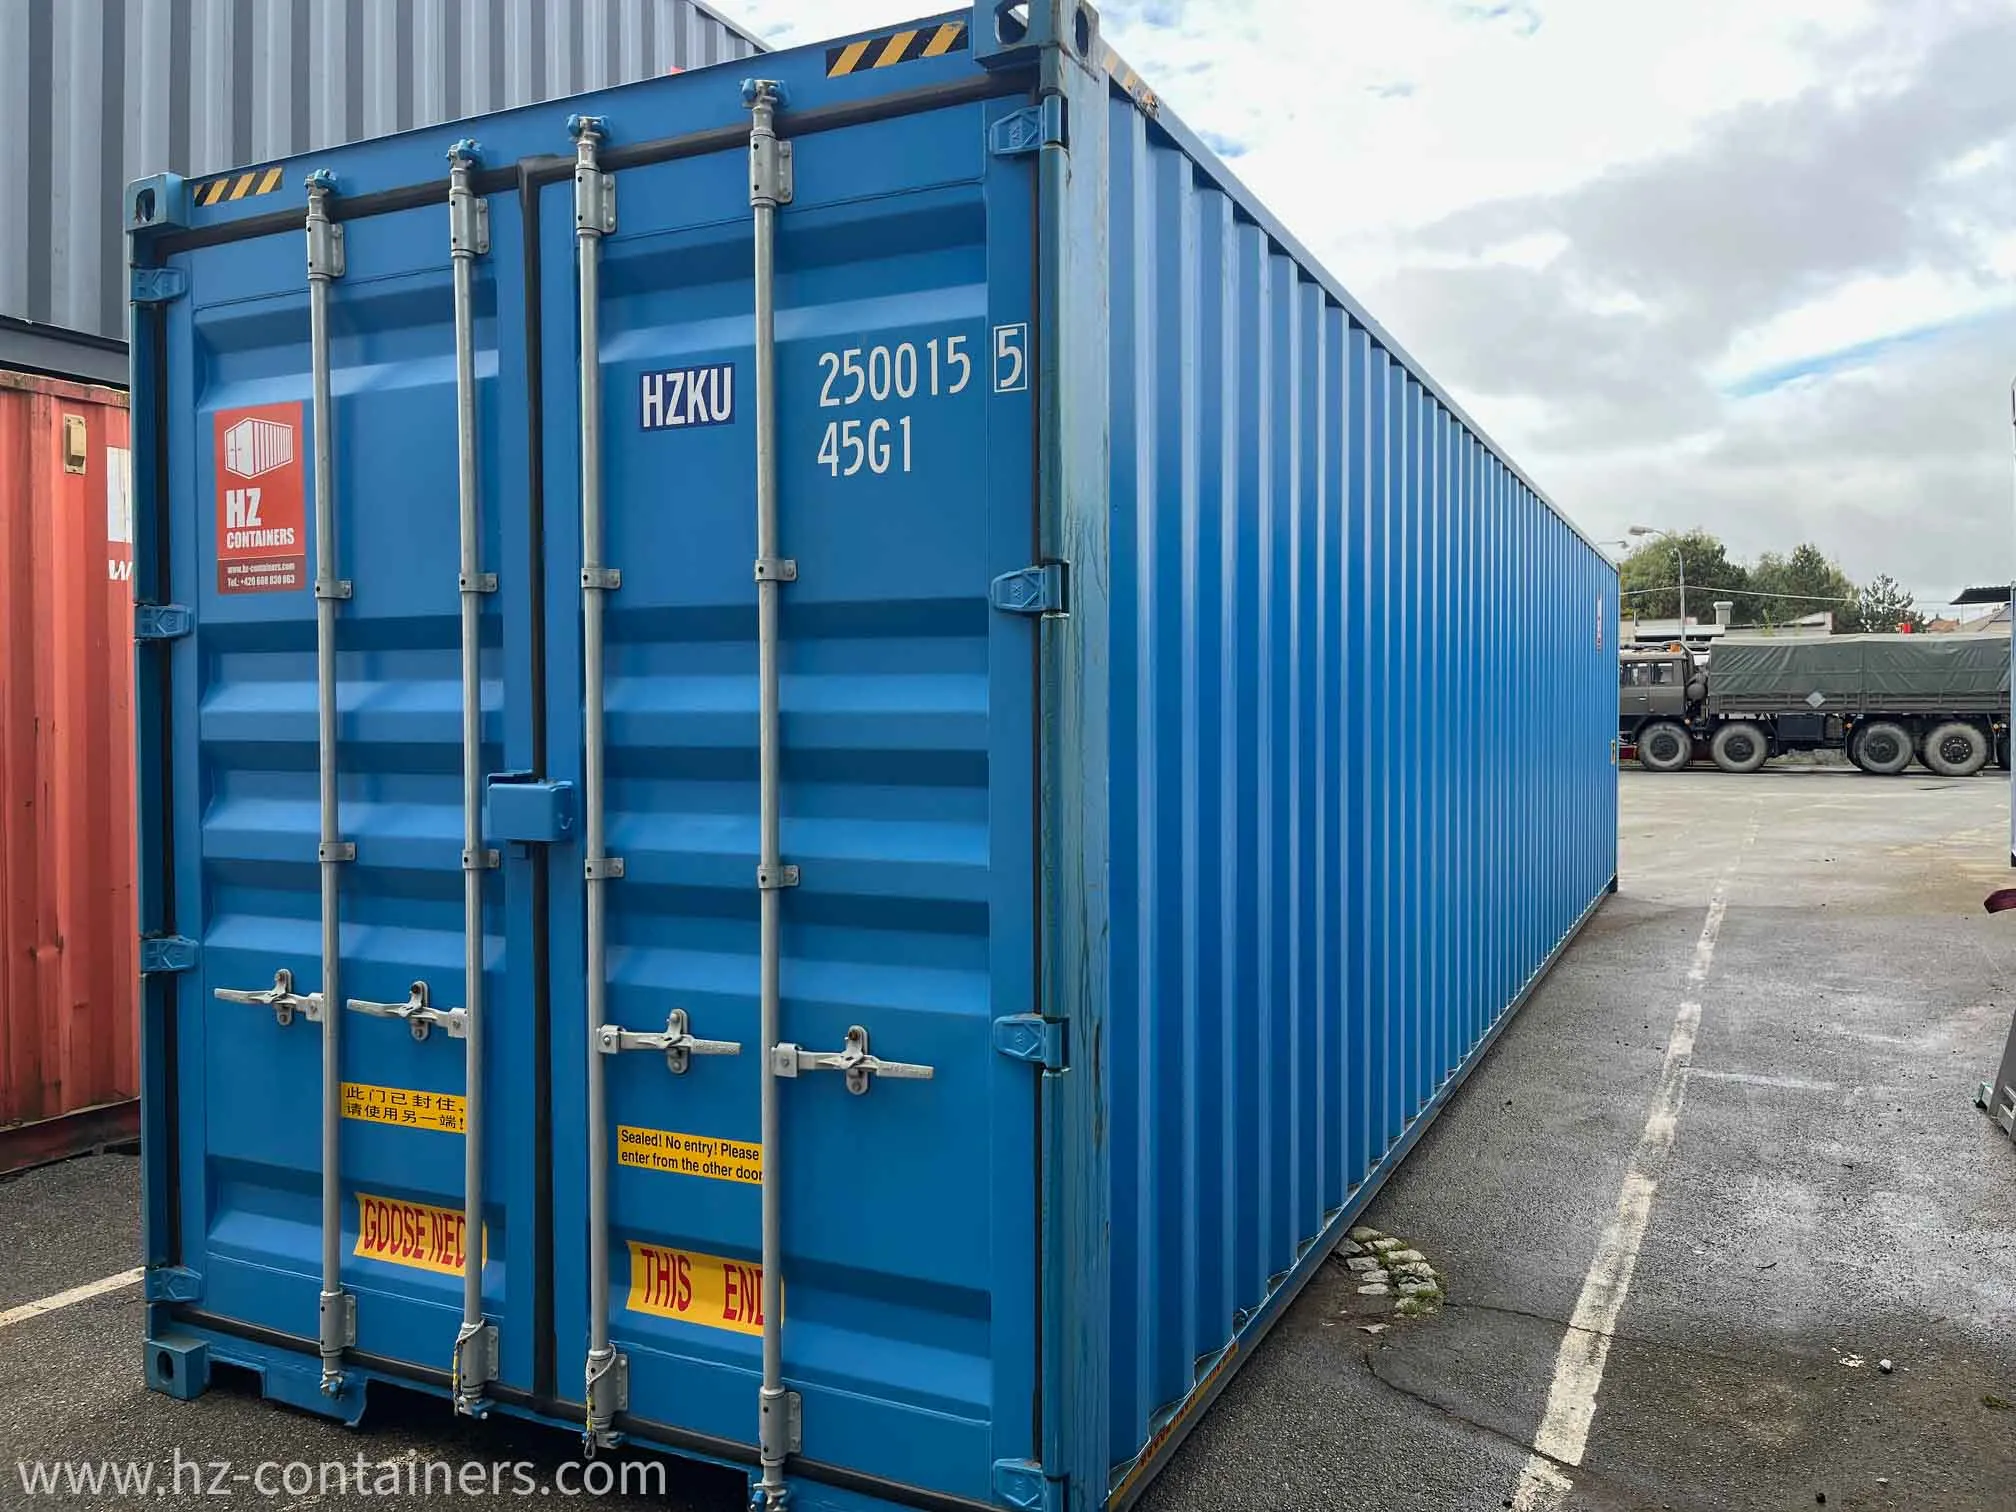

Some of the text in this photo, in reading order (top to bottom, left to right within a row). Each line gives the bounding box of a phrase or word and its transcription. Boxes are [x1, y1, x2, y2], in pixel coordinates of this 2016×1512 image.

[642, 328, 1023, 428] HZKU 250015 5
[817, 415, 911, 477] 45G1
[225, 488, 262, 528] HZ
[226, 528, 295, 549] CONTAINERS
[621, 1129, 759, 1161] Sealed! No entry! Please
[621, 1151, 649, 1164] enter
[652, 1152, 678, 1169] from
[681, 1157, 699, 1172] the
[703, 1161, 734, 1177] other
[363, 1199, 467, 1268] GOOSE NEC
[640, 1248, 692, 1312] THIS
